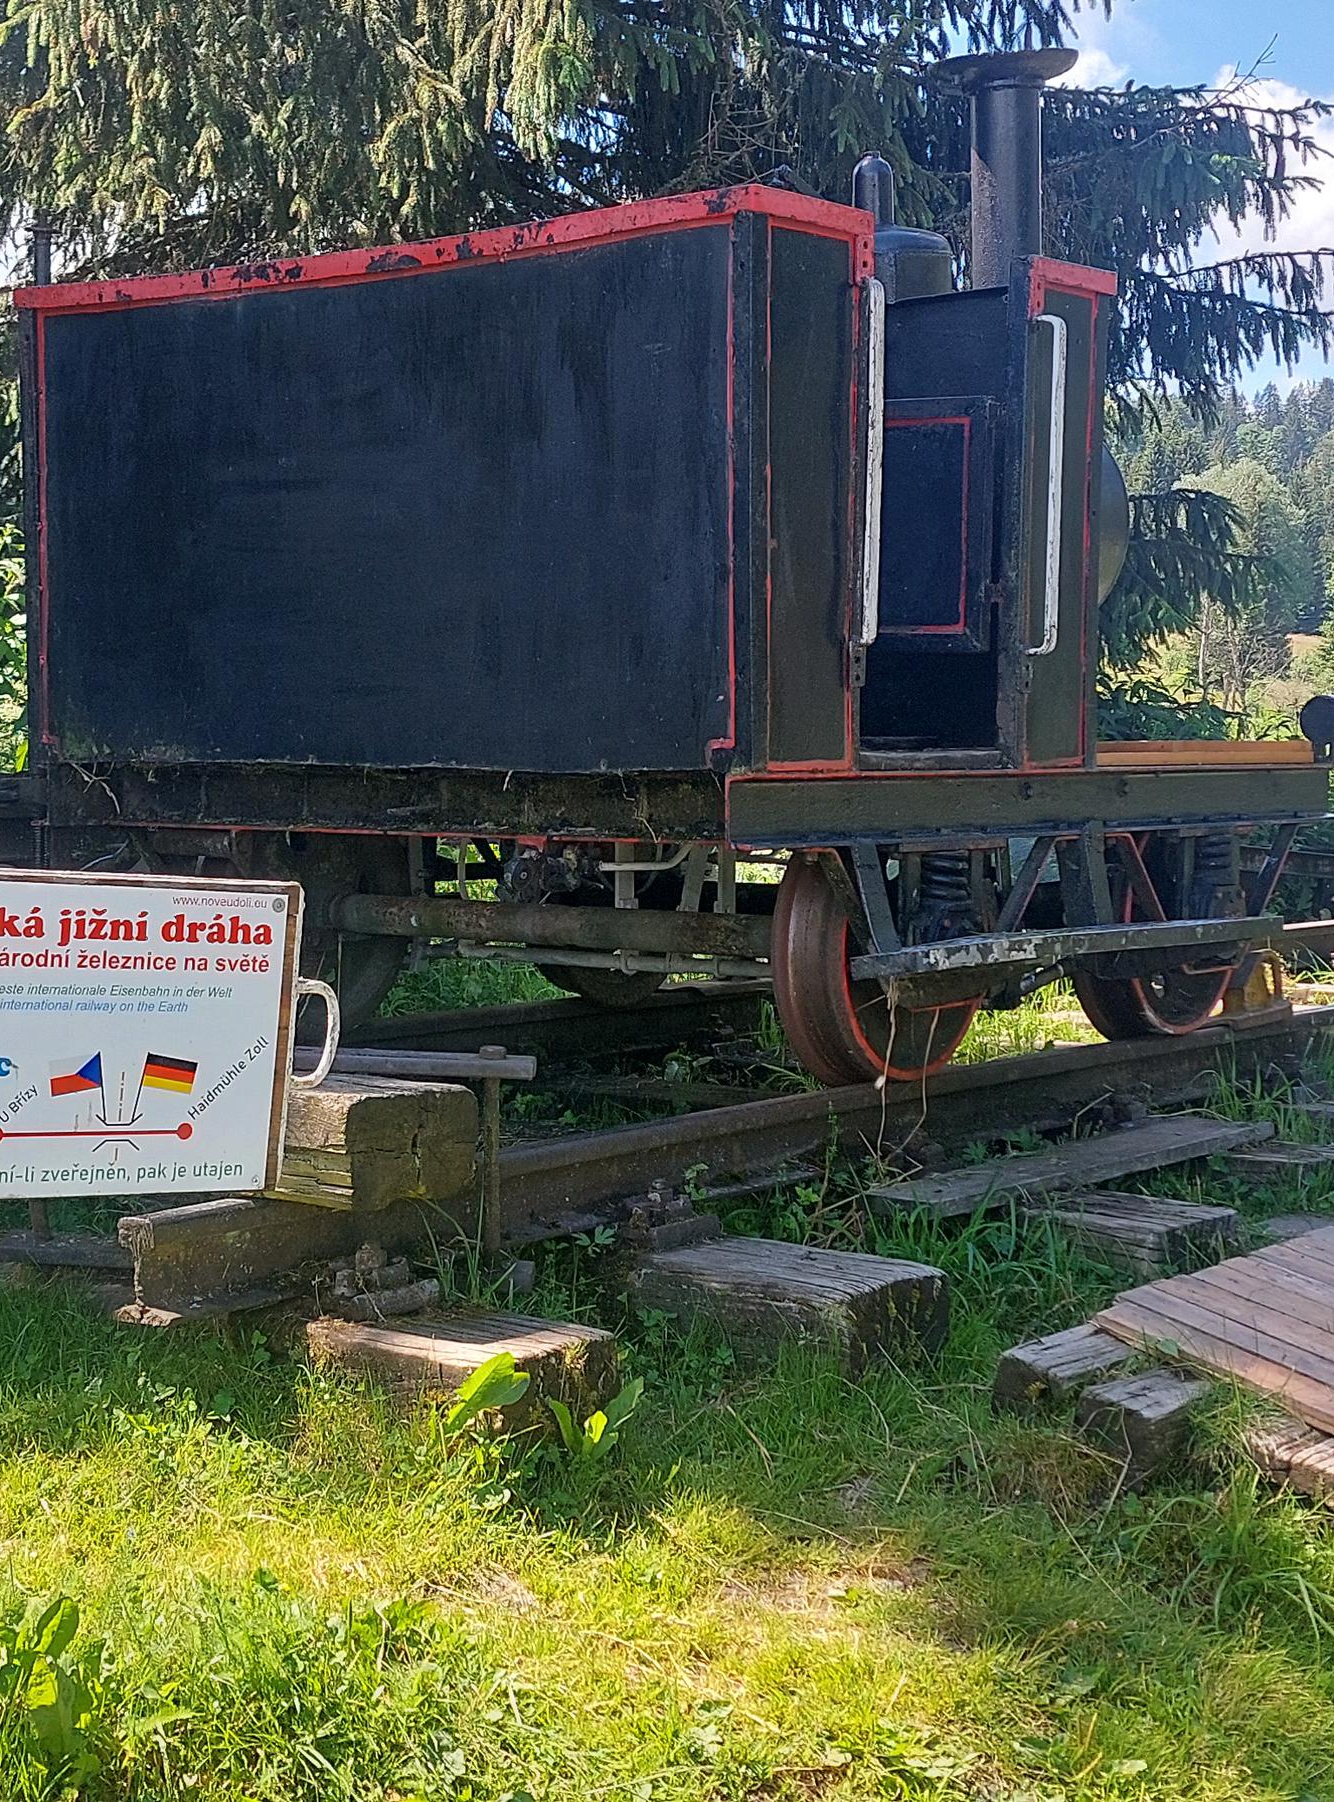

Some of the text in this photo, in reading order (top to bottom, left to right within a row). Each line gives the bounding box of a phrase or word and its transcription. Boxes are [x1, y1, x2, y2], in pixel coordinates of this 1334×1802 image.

[57, 908, 149, 946] jižní
[161, 913, 273, 945] dráha
[77, 950, 176, 971] železnice
[184, 956, 208, 972] na
[215, 953, 269, 973] světě
[27, 983, 107, 996] internationale
[110, 984, 170, 997] Eisenbahn
[172, 986, 183, 998] in
[186, 986, 205, 998] der
[208, 986, 232, 998] Welt
[0, 998, 73, 1012] international
[75, 1000, 116, 1014] railway
[119, 1003, 134, 1012] on
[137, 1001, 155, 1012] the
[158, 1001, 188, 1013] Earth
[187, 1036, 269, 1120] Haidmühle Zoll
[8, 1084, 39, 1114] Břízy
[41, 1162, 130, 1185] zveřejněn,
[137, 1164, 167, 1183] pak
[170, 1163, 187, 1182] je
[193, 1160, 243, 1181] utajen
